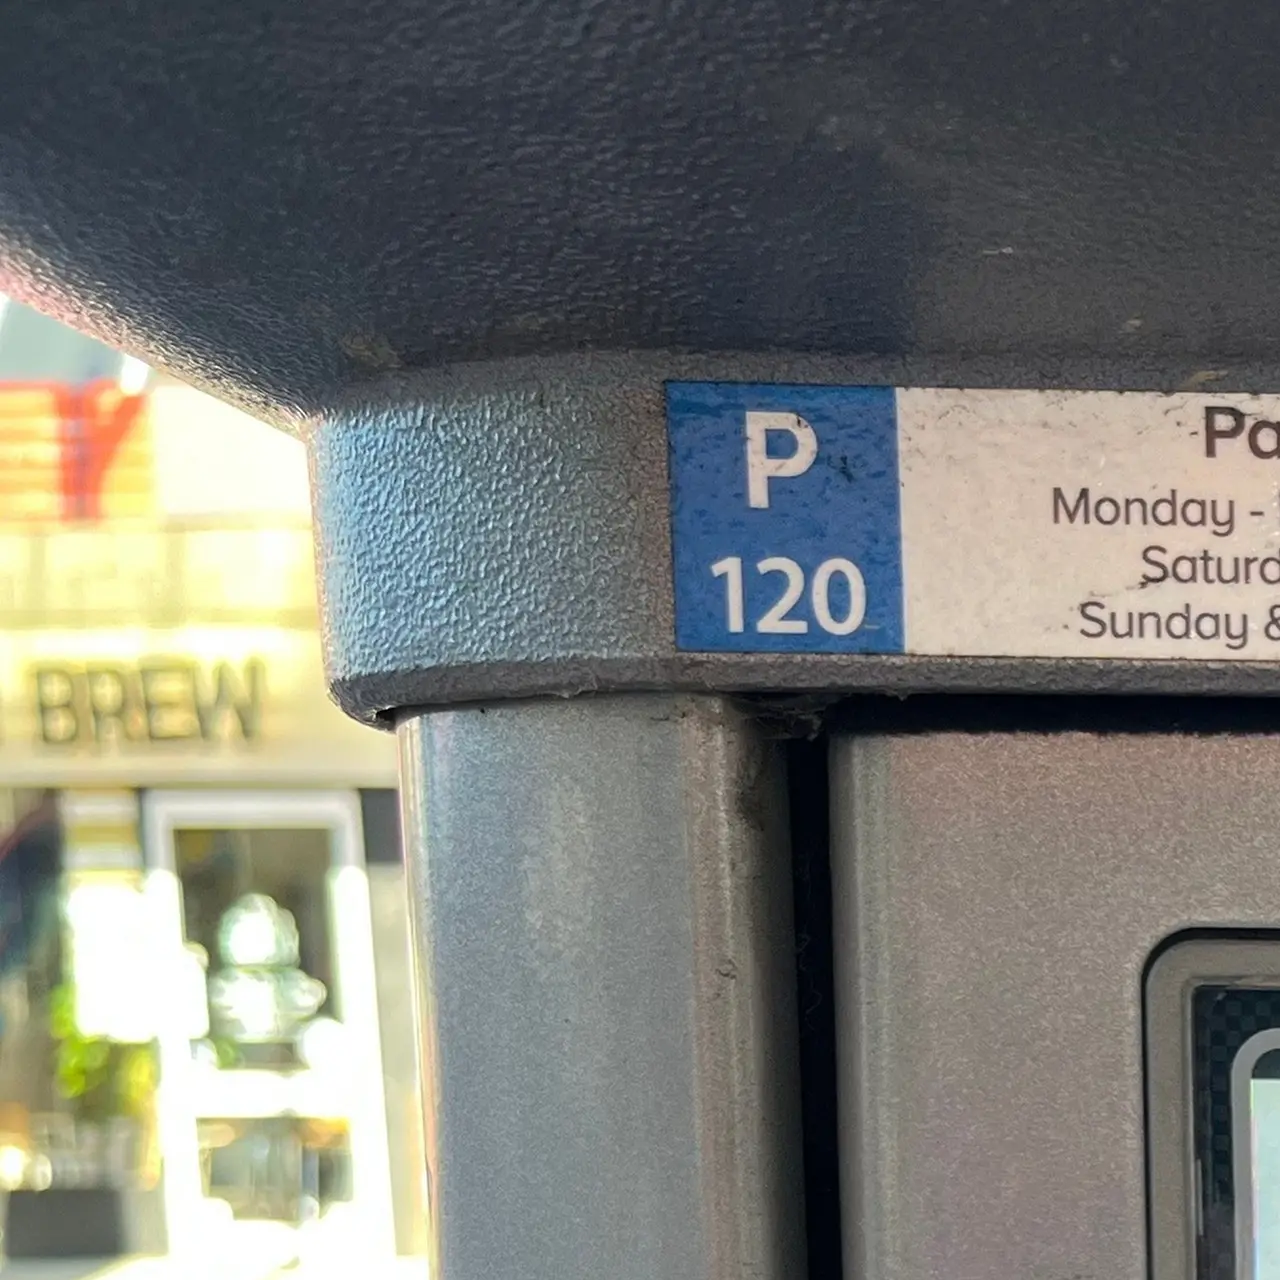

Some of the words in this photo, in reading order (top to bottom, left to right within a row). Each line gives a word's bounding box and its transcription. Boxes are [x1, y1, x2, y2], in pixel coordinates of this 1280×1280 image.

[744, 411, 818, 509] P
[1053, 487, 1235, 537] Monday
[711, 557, 866, 636] 120
[1079, 602, 1248, 650] Sunday
[34, 661, 266, 746] BREW
